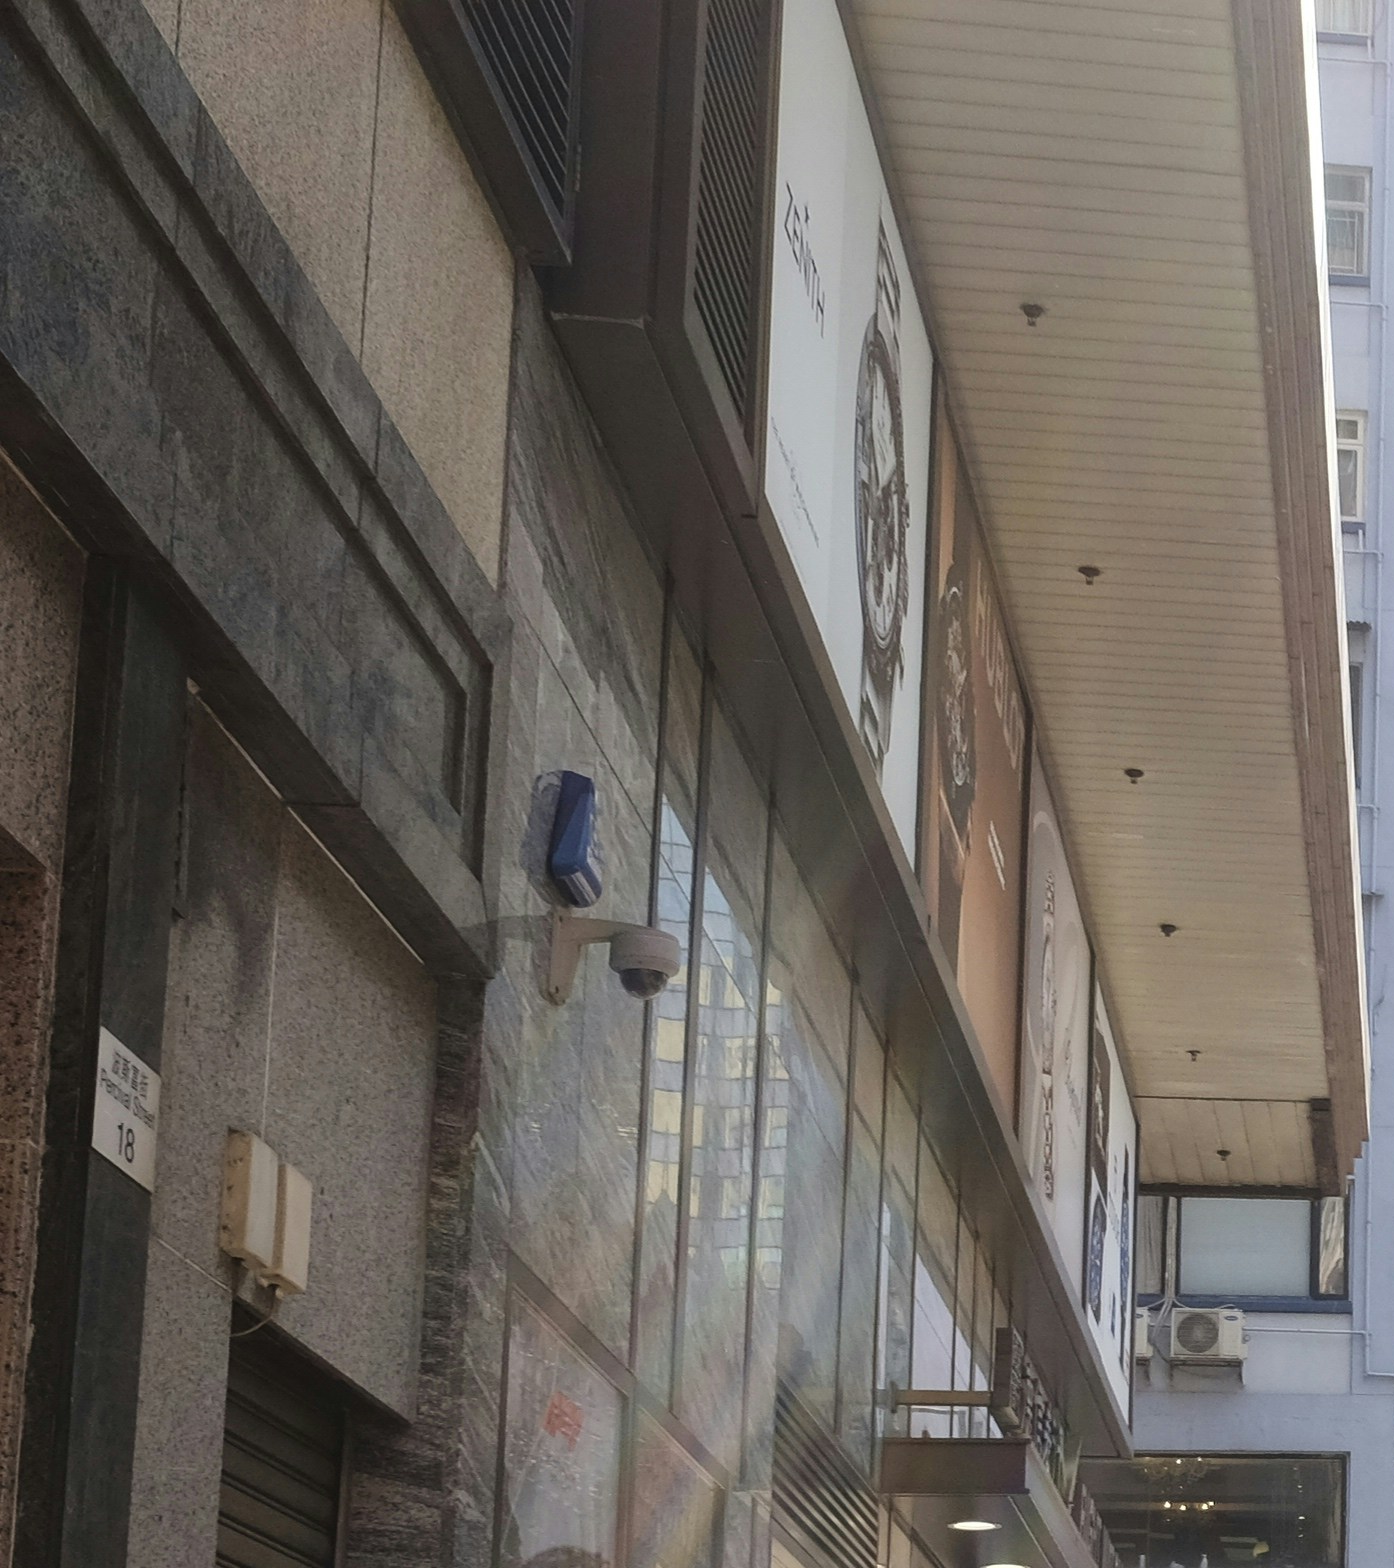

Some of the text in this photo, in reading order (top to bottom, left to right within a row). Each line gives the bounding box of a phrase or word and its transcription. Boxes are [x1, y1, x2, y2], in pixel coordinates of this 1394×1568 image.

[785, 181, 826, 339] ZENITH
[975, 559, 1026, 792] HUBLOT
[117, 1121, 136, 1164] 18
